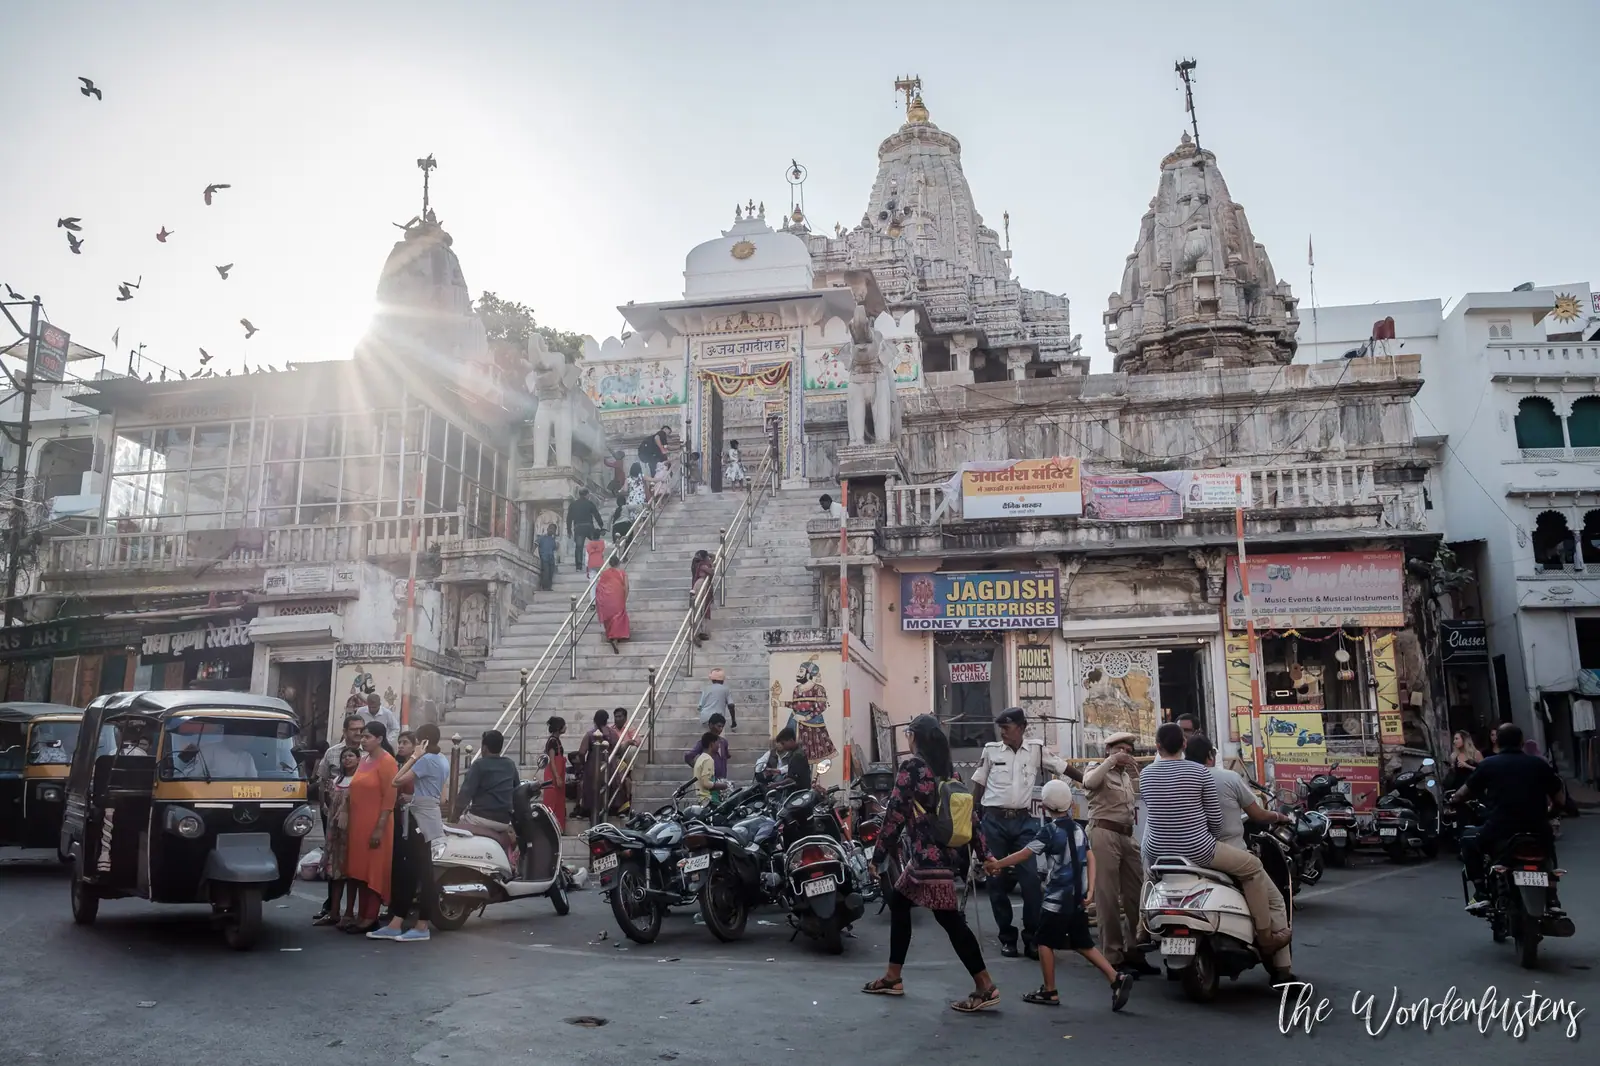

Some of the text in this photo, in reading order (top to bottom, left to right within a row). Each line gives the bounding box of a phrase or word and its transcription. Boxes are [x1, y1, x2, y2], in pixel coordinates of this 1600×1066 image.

[736, 338, 773, 353] जगदीश
[774, 337, 786, 350] हरे
[968, 462, 1074, 483] जगदीश मंदिर
[1002, 501, 1021, 509] दैनिक
[946, 579, 1055, 601] JAGDISH
[1264, 596, 1286, 604] Music
[1353, 594, 1399, 602] Instruments
[946, 602, 1055, 617] ENTERPRISES
[906, 618, 1056, 629] MONEY EXCHANGE
[32, 626, 71, 646] ART
[1446, 630, 1486, 648] Classes
[1018, 649, 1052, 667] MONEY
[951, 664, 987, 673] MONEY
[1018, 667, 1052, 681] EXCHANGE
[951, 672, 989, 682] EXCHANGE
